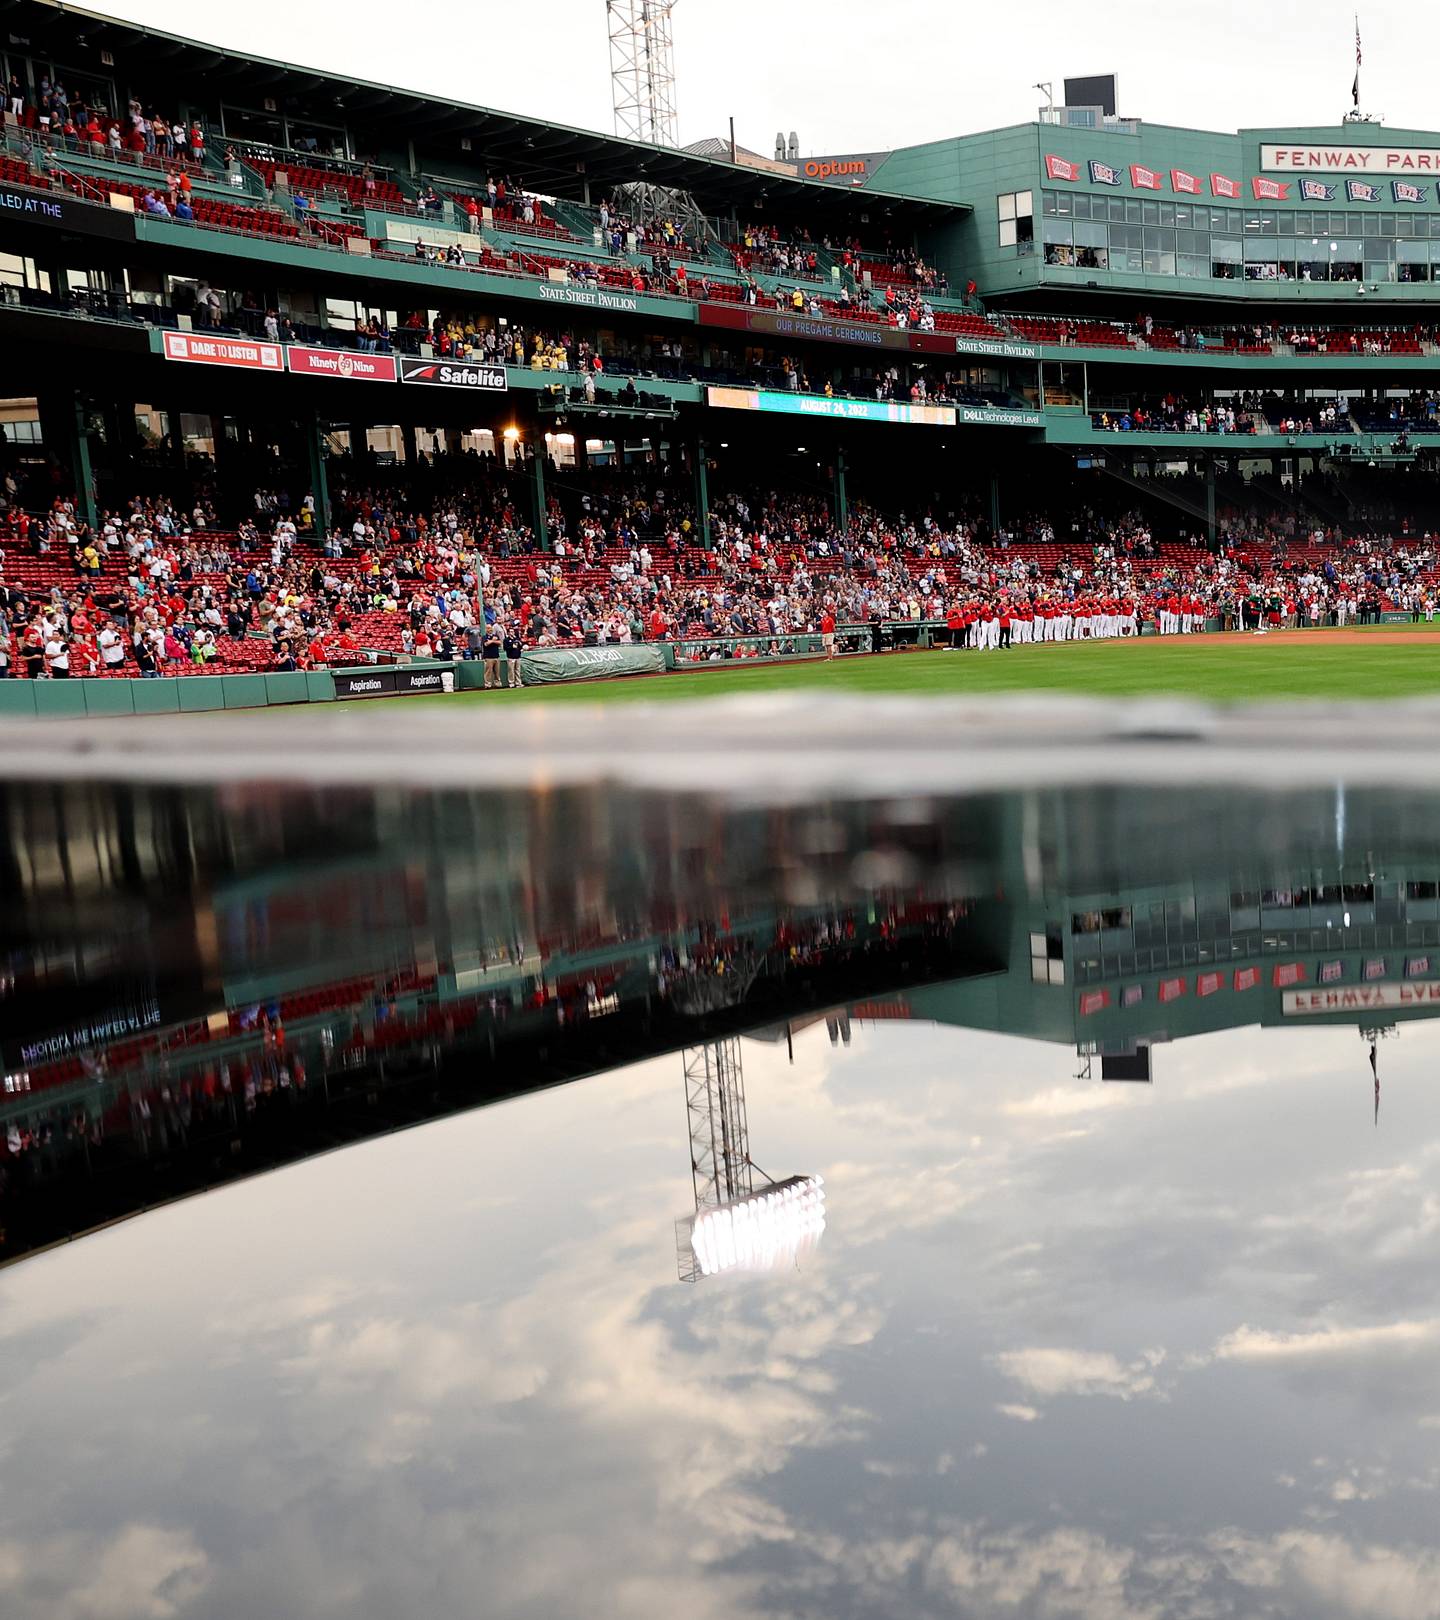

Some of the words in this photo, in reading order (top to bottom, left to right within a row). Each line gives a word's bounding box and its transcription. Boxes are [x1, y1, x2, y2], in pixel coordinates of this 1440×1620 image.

[1275, 151, 1370, 168] FENWAY
[805, 160, 865, 179] Optum
[25, 198, 38, 212] AT
[40, 201, 62, 218] THE
[540, 285, 565, 300] STATE
[598, 293, 637, 310] PAVILION
[776, 319, 793, 331] OUR
[795, 321, 833, 337] PREGAME
[836, 327, 882, 343] CEREMONIES
[191, 341, 216, 356] DARE
[217, 344, 227, 358] TO
[227, 345, 258, 361] LISTEN
[958, 340, 978, 352] STATE
[1004, 344, 1035, 357] PAVILION
[309, 356, 338, 371] Ninety
[353, 361, 375, 373] Nine
[440, 366, 504, 387] Safelite
[963, 410, 983, 421] DELL
[983, 411, 1022, 424] Technologies
[1023, 414, 1040, 424] Level
[350, 680, 381, 692] Aspiration
[411, 674, 440, 687] Aspiration
